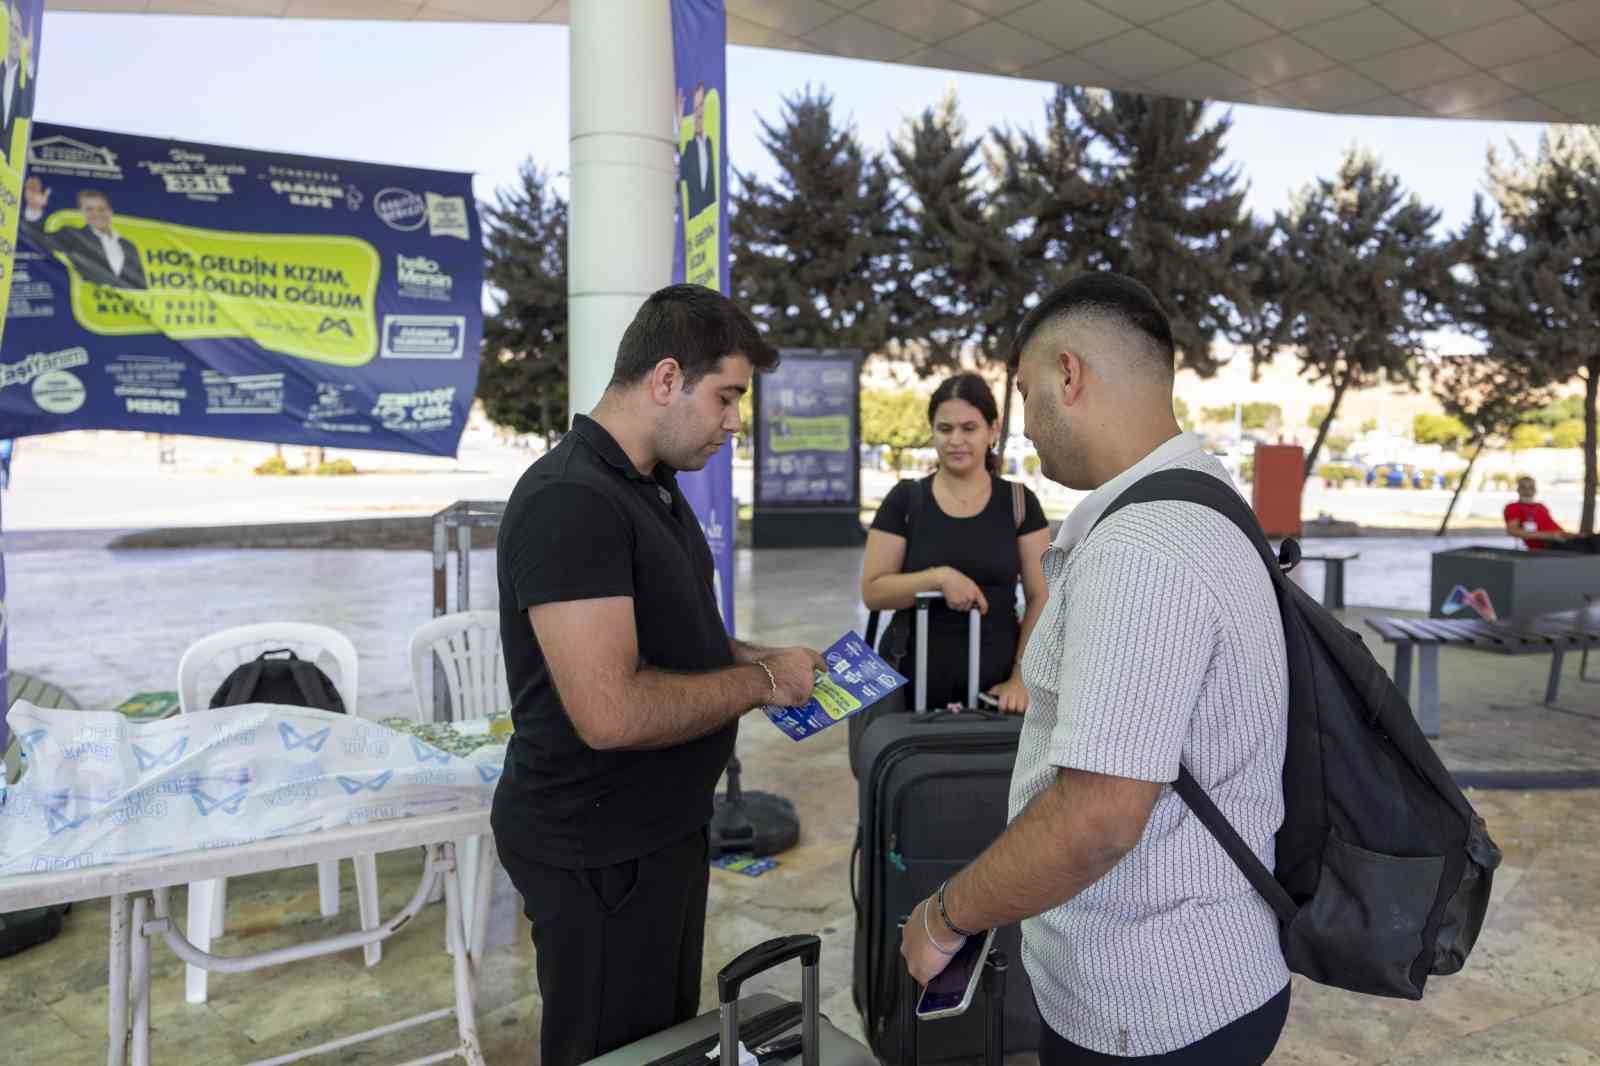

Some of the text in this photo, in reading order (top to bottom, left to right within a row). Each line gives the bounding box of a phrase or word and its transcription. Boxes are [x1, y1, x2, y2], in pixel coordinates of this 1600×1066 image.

[146, 249, 349, 288] HOŞ GELDİN KIZIM,
[284, 282, 364, 310] OĞLUM
